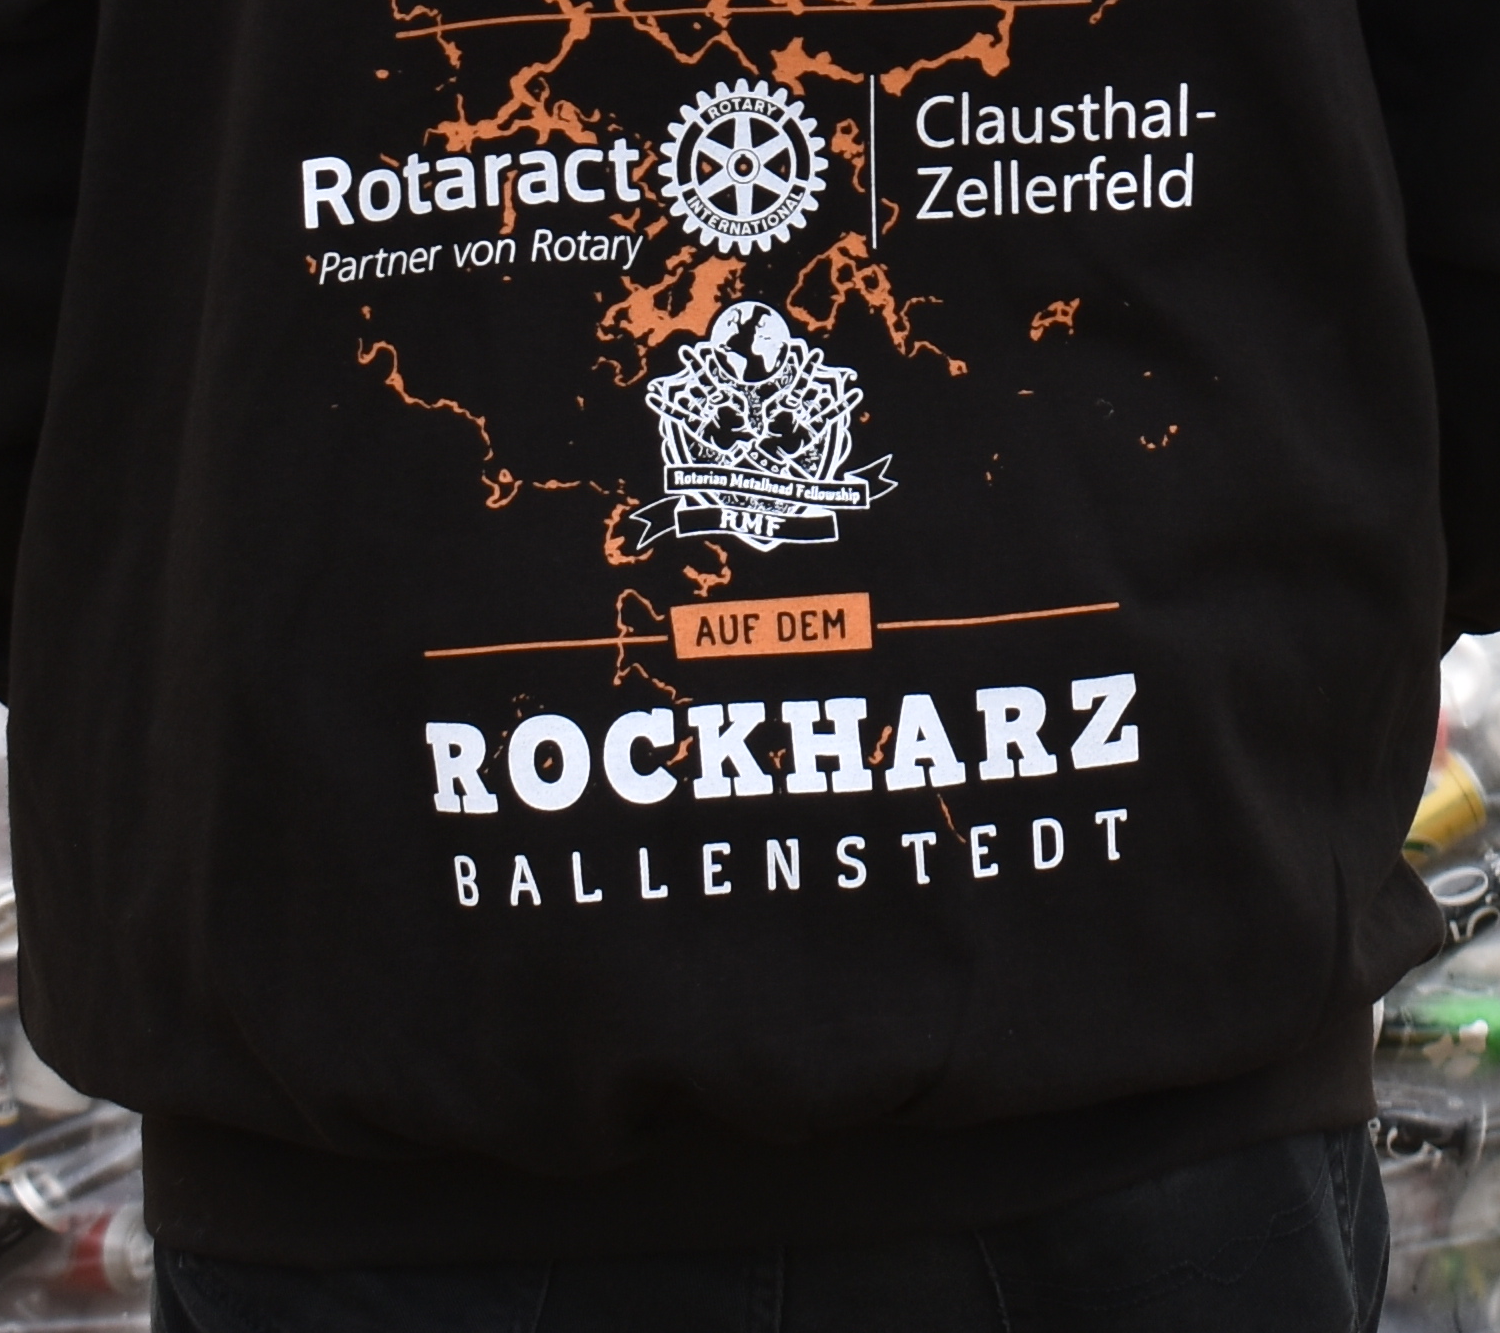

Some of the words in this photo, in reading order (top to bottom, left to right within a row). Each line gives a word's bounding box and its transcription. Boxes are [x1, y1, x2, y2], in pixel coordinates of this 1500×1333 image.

[707, 98, 777, 120] ROTARY
[917, 83, 1217, 148] Clausthal-
[302, 138, 640, 228] Rotaract
[917, 153, 1194, 219] Zellerfeld
[687, 191, 804, 236] INTERNATIONAL
[319, 245, 442, 284] Partner
[454, 238, 516, 268] von
[531, 229, 644, 269] Rotary
[673, 471, 728, 487] Rotarian
[729, 473, 794, 497] Metalhead
[796, 484, 861, 505] Fellowship
[719, 511, 787, 538] RMF
[696, 614, 760, 647] AUF
[777, 608, 846, 642] DEM
[426, 674, 1139, 813] ROCKHARZ
[454, 809, 1127, 906] BALLENSTEDT
